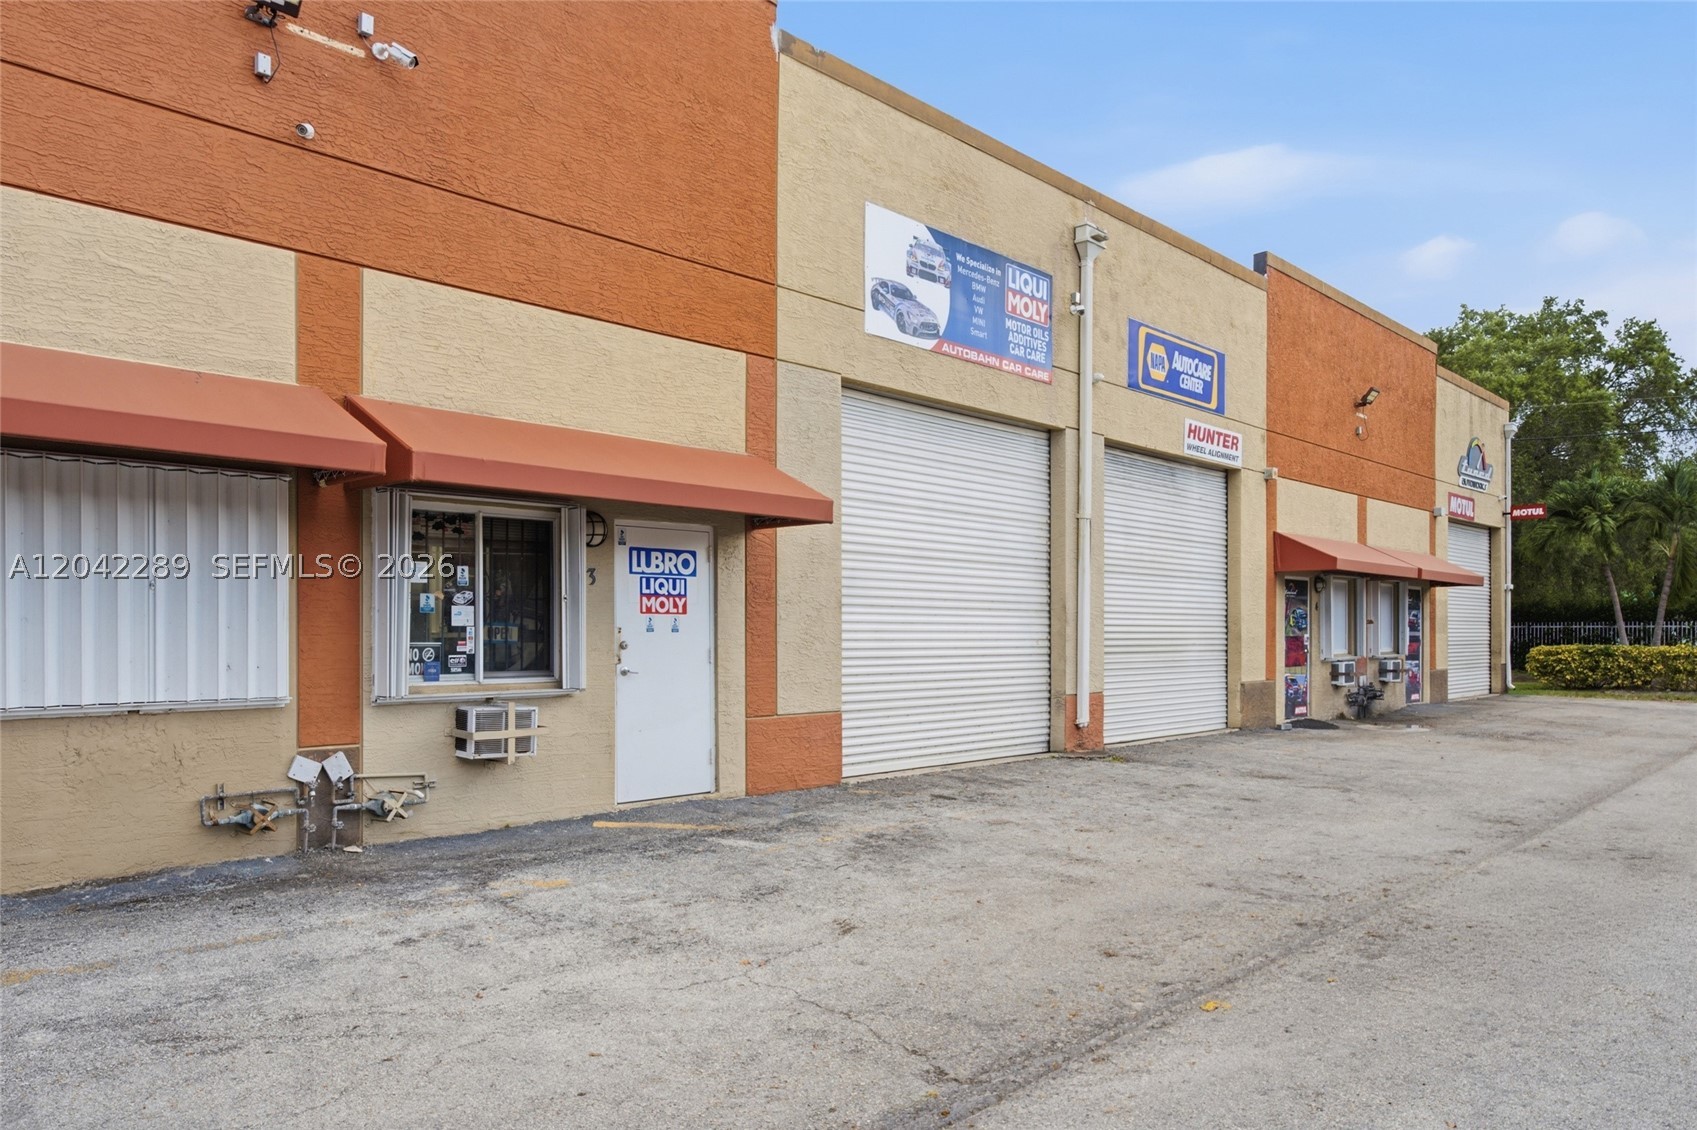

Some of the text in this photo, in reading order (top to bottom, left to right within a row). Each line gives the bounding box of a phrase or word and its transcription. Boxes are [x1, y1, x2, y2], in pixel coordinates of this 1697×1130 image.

[956, 252, 1002, 276] We Specialize in
[957, 265, 1000, 288] Mercedes-Benz
[972, 282, 986, 292] BMW
[1008, 267, 1047, 300] LIQUI
[972, 294, 986, 304] Audi
[1007, 291, 1048, 323] MOLY
[974, 305, 984, 315] VW
[972, 316, 986, 327] MINI
[1005, 317, 1049, 342] MOTOR OILS
[970, 326, 988, 339] Smart
[1008, 332, 1047, 353] ADDITIVES
[942, 343, 1049, 381] AUTOBAHN CAR CARE
[1009, 343, 1046, 364] CAR CARE
[1150, 351, 1166, 374] NAPA
[1179, 374, 1204, 394] CENTER
[1188, 423, 1239, 450] HUNTER
[1187, 444, 1239, 462] WHEEL ALIGNMENT
[1450, 496, 1474, 517] MOTUL
[1513, 508, 1544, 517] MOTUL
[631, 549, 696, 576] LUBRO
[641, 577, 686, 596] LIQUI
[641, 596, 687, 614] MOLY
